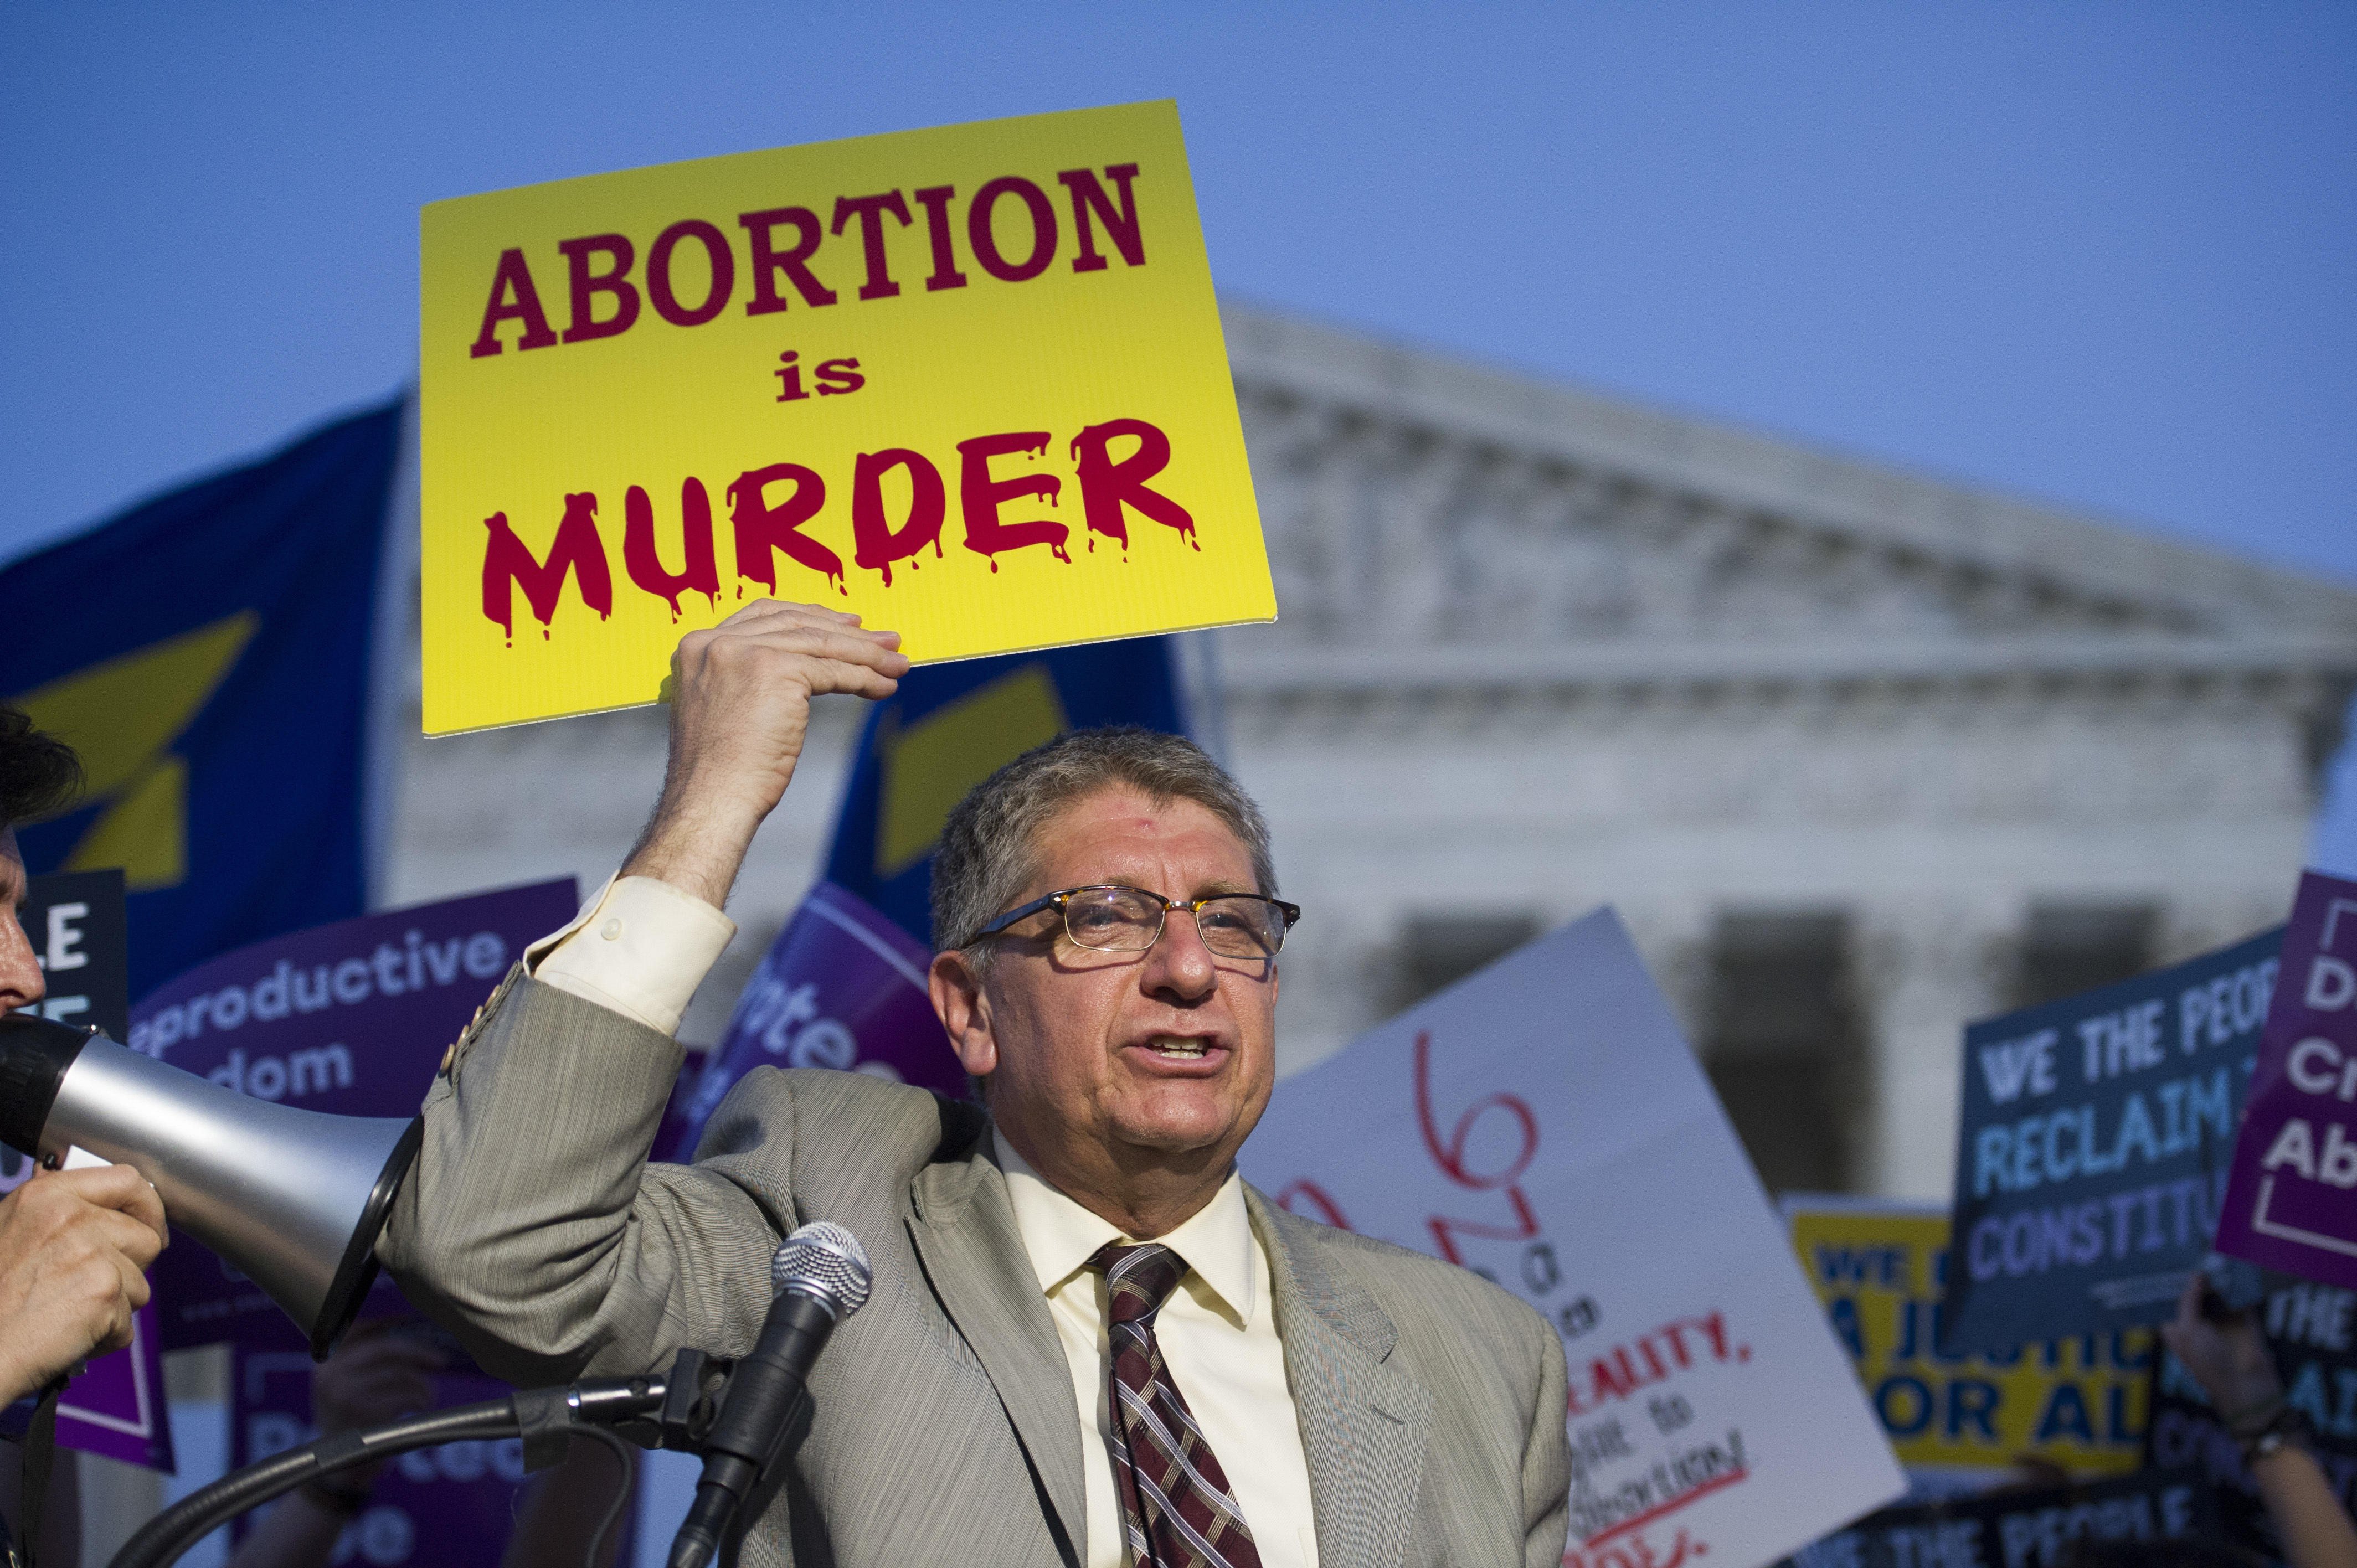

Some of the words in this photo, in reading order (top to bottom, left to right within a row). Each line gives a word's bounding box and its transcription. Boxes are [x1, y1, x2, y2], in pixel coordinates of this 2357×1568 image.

[471, 162, 1147, 359] ABORTION
[774, 350, 866, 403] is
[482, 417, 1201, 648] MURDER
[1979, 1027, 2059, 1106] WE
[2075, 998, 2166, 1084] THE
[1973, 1064, 2232, 1199] RECLAIM
[1875, 1375, 2000, 1440] OR
